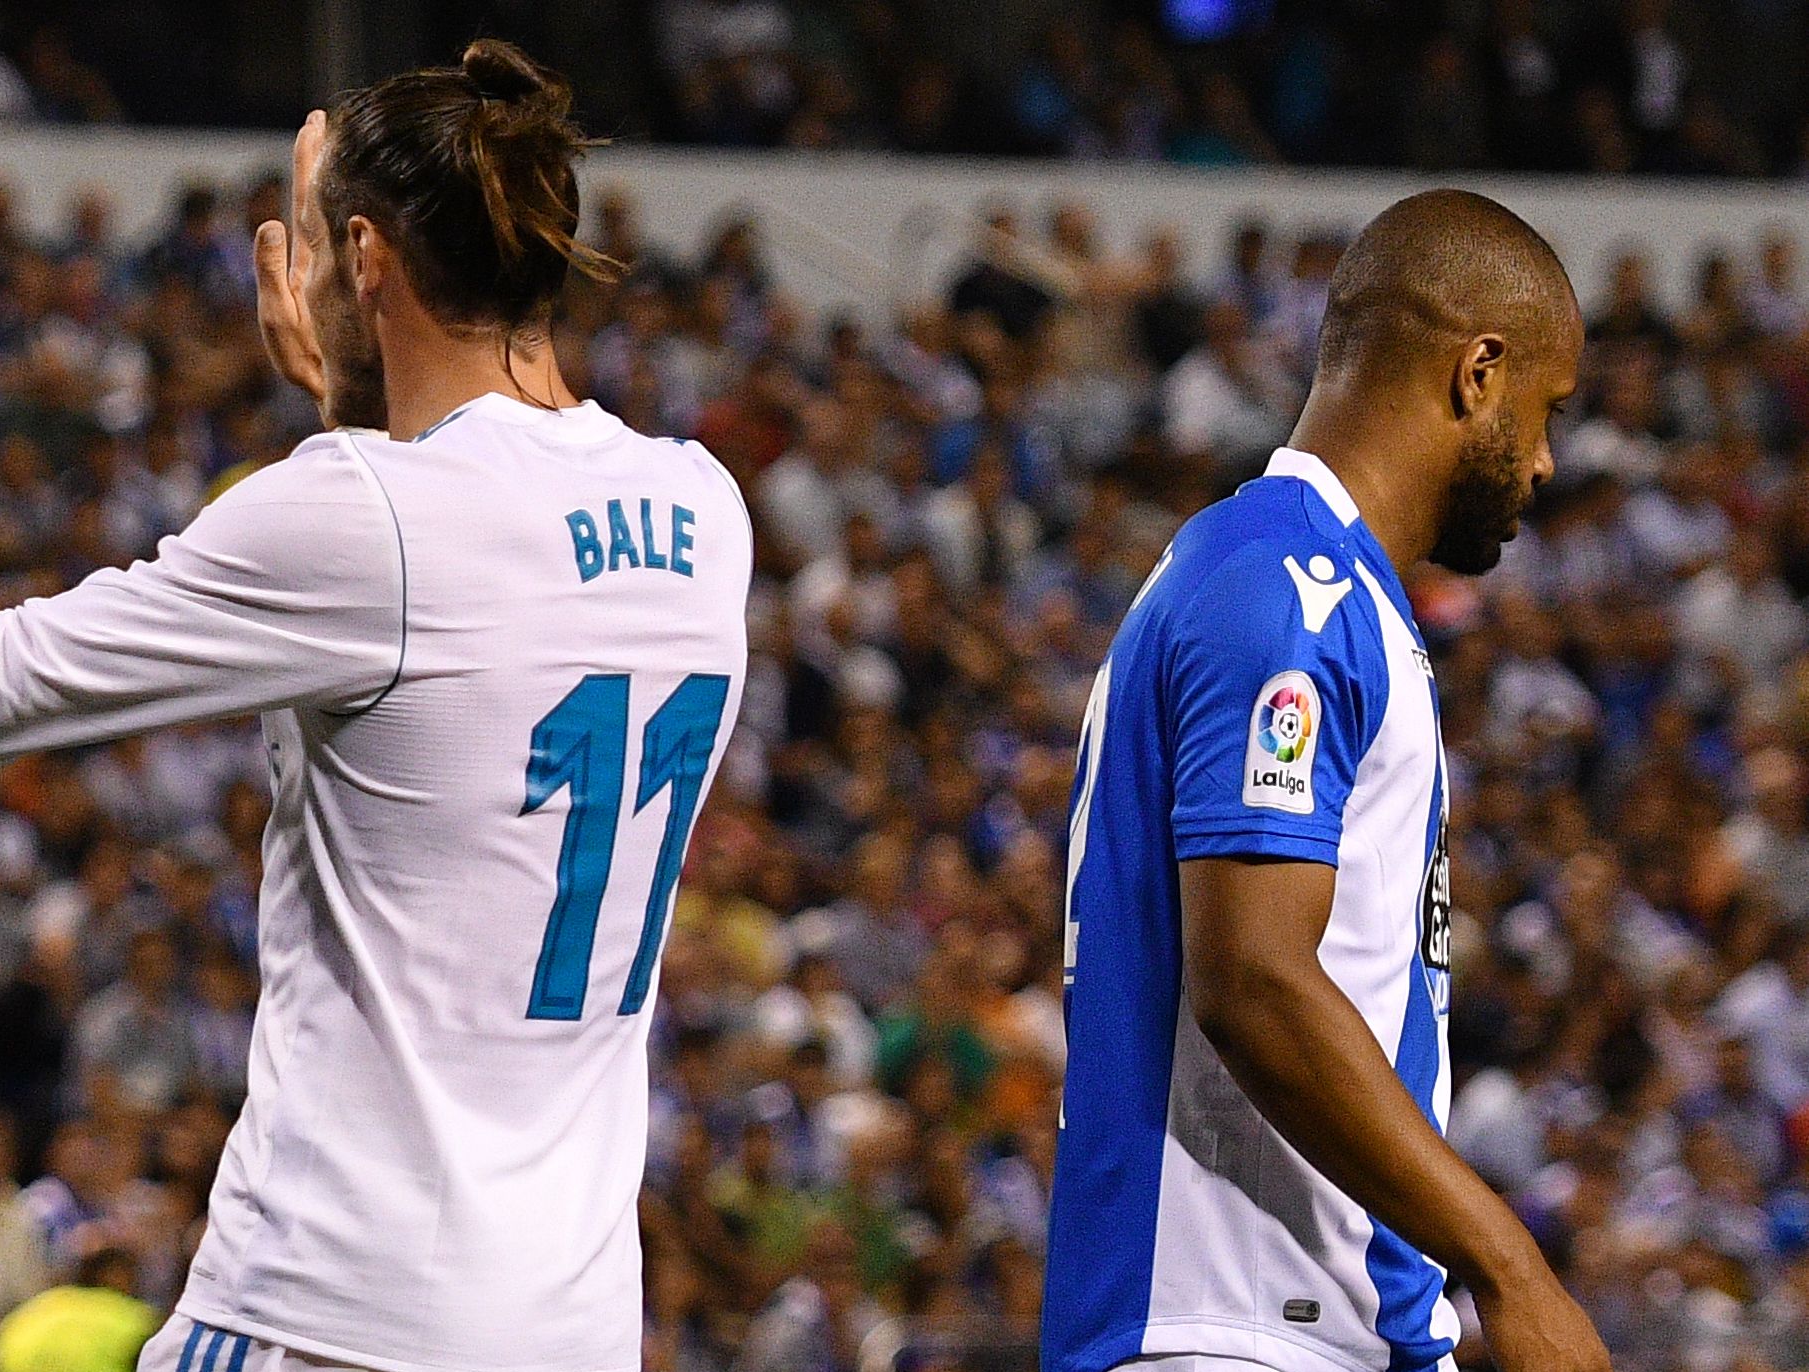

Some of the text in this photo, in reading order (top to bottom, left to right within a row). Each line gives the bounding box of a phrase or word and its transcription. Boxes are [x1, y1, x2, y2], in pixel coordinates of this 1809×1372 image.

[564, 498, 695, 584] BALE
[1252, 768, 1306, 796] LaLiga
[518, 673, 731, 1022] 11
